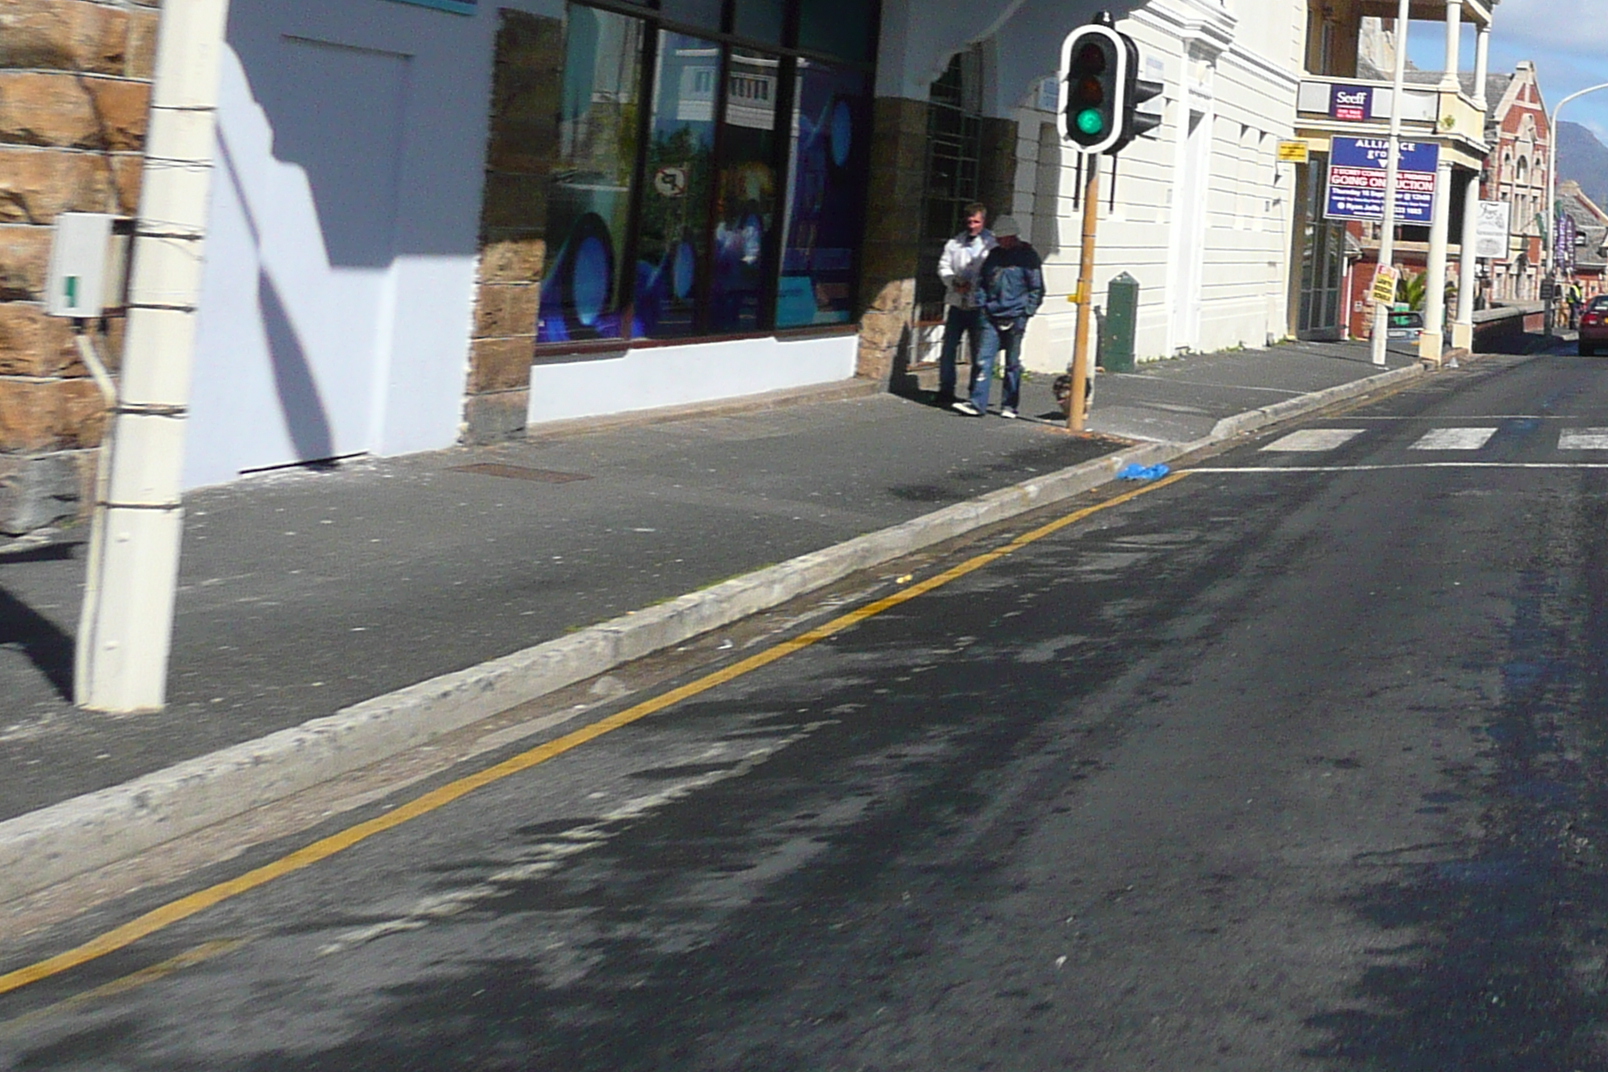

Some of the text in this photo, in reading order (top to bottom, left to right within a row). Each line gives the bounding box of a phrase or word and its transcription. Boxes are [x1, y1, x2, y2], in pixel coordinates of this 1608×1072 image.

[1336, 91, 1367, 105] Seeff
[1355, 139, 1416, 152] ALLIACE
[1331, 175, 1368, 186] GOING
[1394, 180, 1433, 191] UCTION
